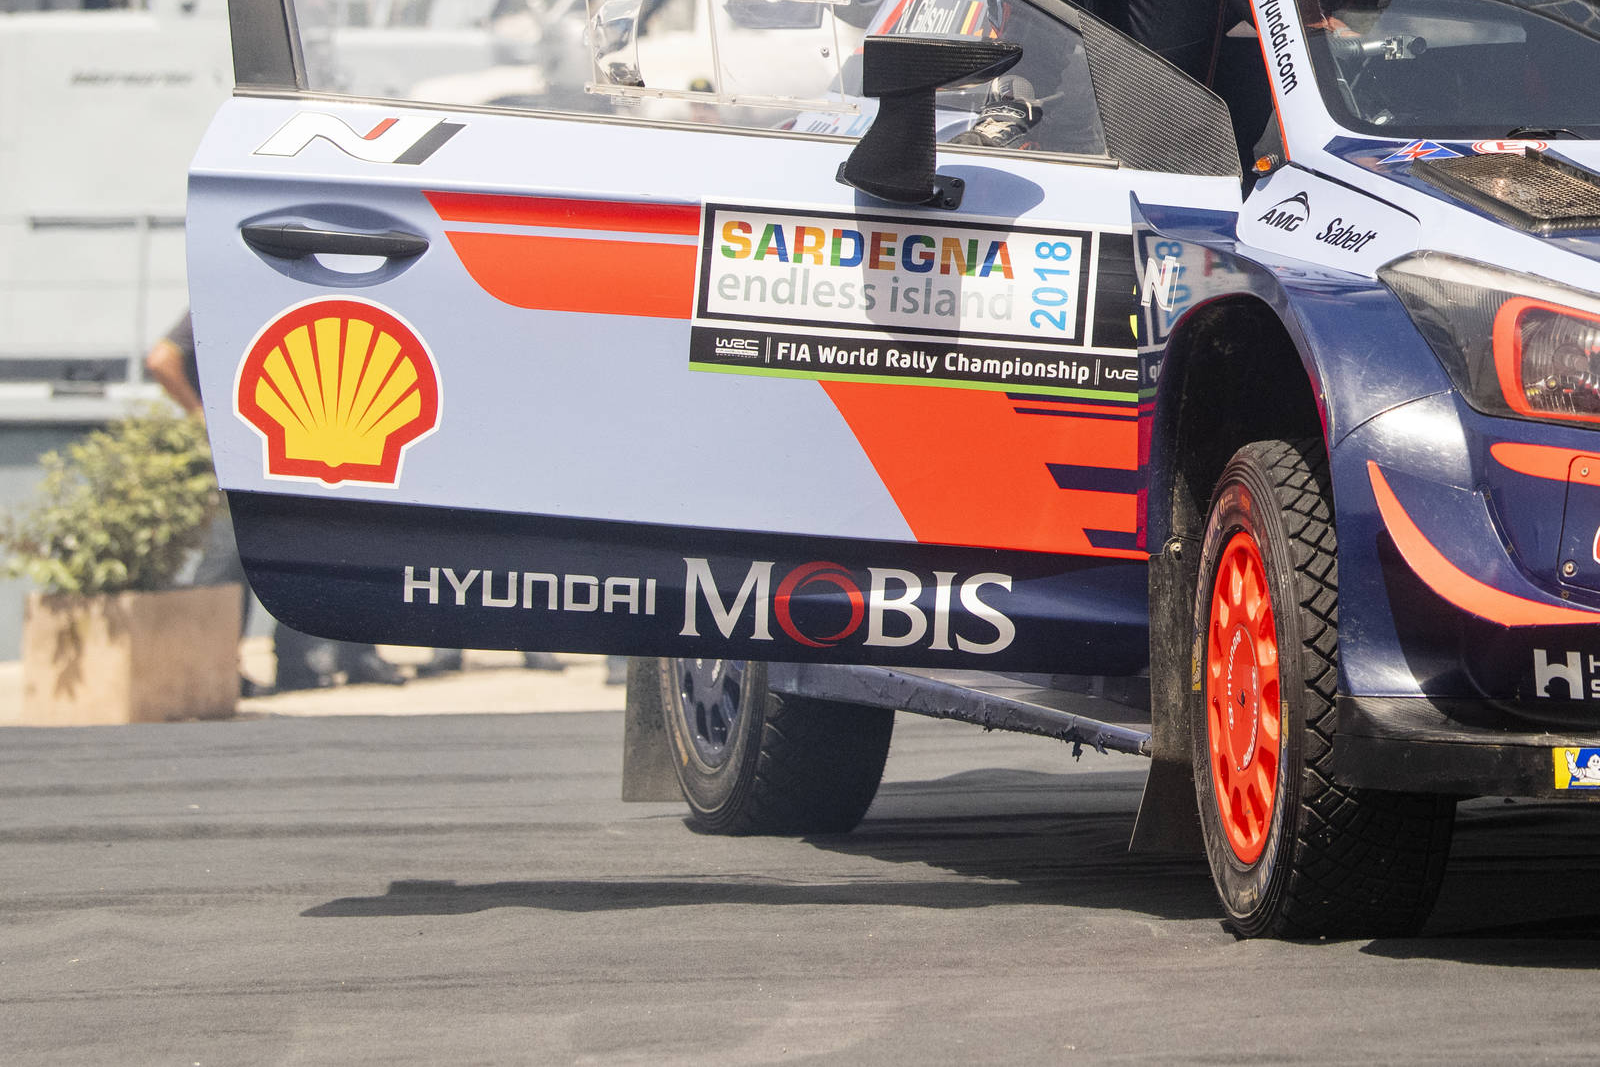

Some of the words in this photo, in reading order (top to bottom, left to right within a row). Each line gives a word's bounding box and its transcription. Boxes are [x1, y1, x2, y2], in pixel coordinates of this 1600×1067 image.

[721, 220, 1014, 280] SARDEGNA
[1316, 218, 1378, 253] Sabelt
[717, 265, 876, 311] endless
[889, 275, 1014, 321] island
[1030, 241, 1072, 331] 2018
[715, 337, 759, 350] WRC
[777, 342, 811, 363] FIA
[818, 345, 878, 367] World
[885, 349, 938, 373] Rally
[944, 352, 1090, 385] Championship
[403, 566, 656, 616] HYUNDAI
[679, 557, 1016, 654] MOBIS
